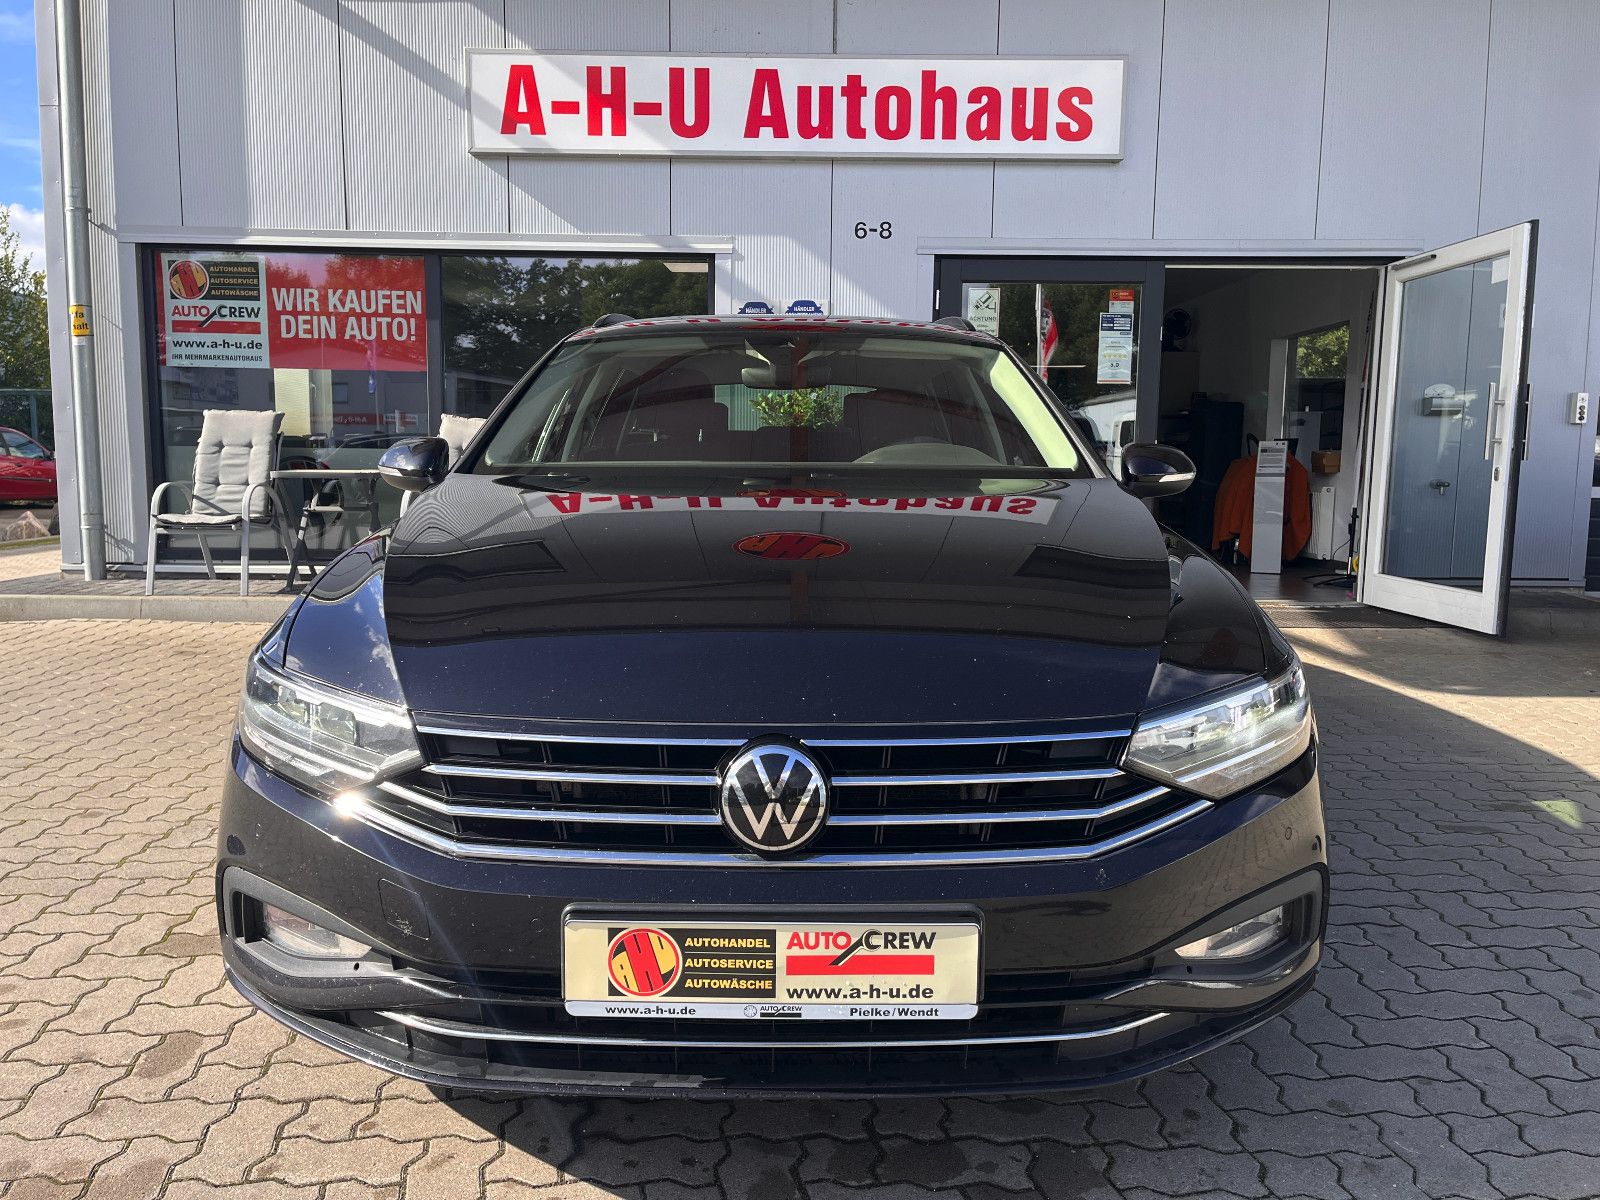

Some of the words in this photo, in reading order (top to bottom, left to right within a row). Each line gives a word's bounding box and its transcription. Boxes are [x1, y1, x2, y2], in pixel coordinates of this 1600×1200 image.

[500, 64, 710, 139] A-H-U
[743, 68, 1094, 142] Autohaus
[854, 221, 893, 240] 6-8
[209, 265, 257, 273] AUTOHANDEL
[271, 287, 321, 312] WIR
[327, 288, 422, 315] KAUFEN
[171, 305, 211, 317] AUTO
[217, 304, 261, 319] CREW
[745, 306, 767, 314] HÄNDLER
[280, 315, 337, 339] DEIN
[343, 316, 417, 341] AUTO!
[172, 339, 263, 350] www.a-h-u.de
[184, 353, 263, 362] MEHRMARKENAUTOHAUS
[722, 746, 826, 850] VW
[684, 937, 771, 948] AUTOHANDEL
[786, 931, 852, 950] AUTO
[862, 929, 937, 951] CREW
[684, 957, 774, 969] AUTOSERVICE
[684, 977, 773, 990] AUTOWÄSCHE
[786, 984, 934, 999] www.a-h-u.de
[605, 1006, 697, 1015] www.a-h-u.de
